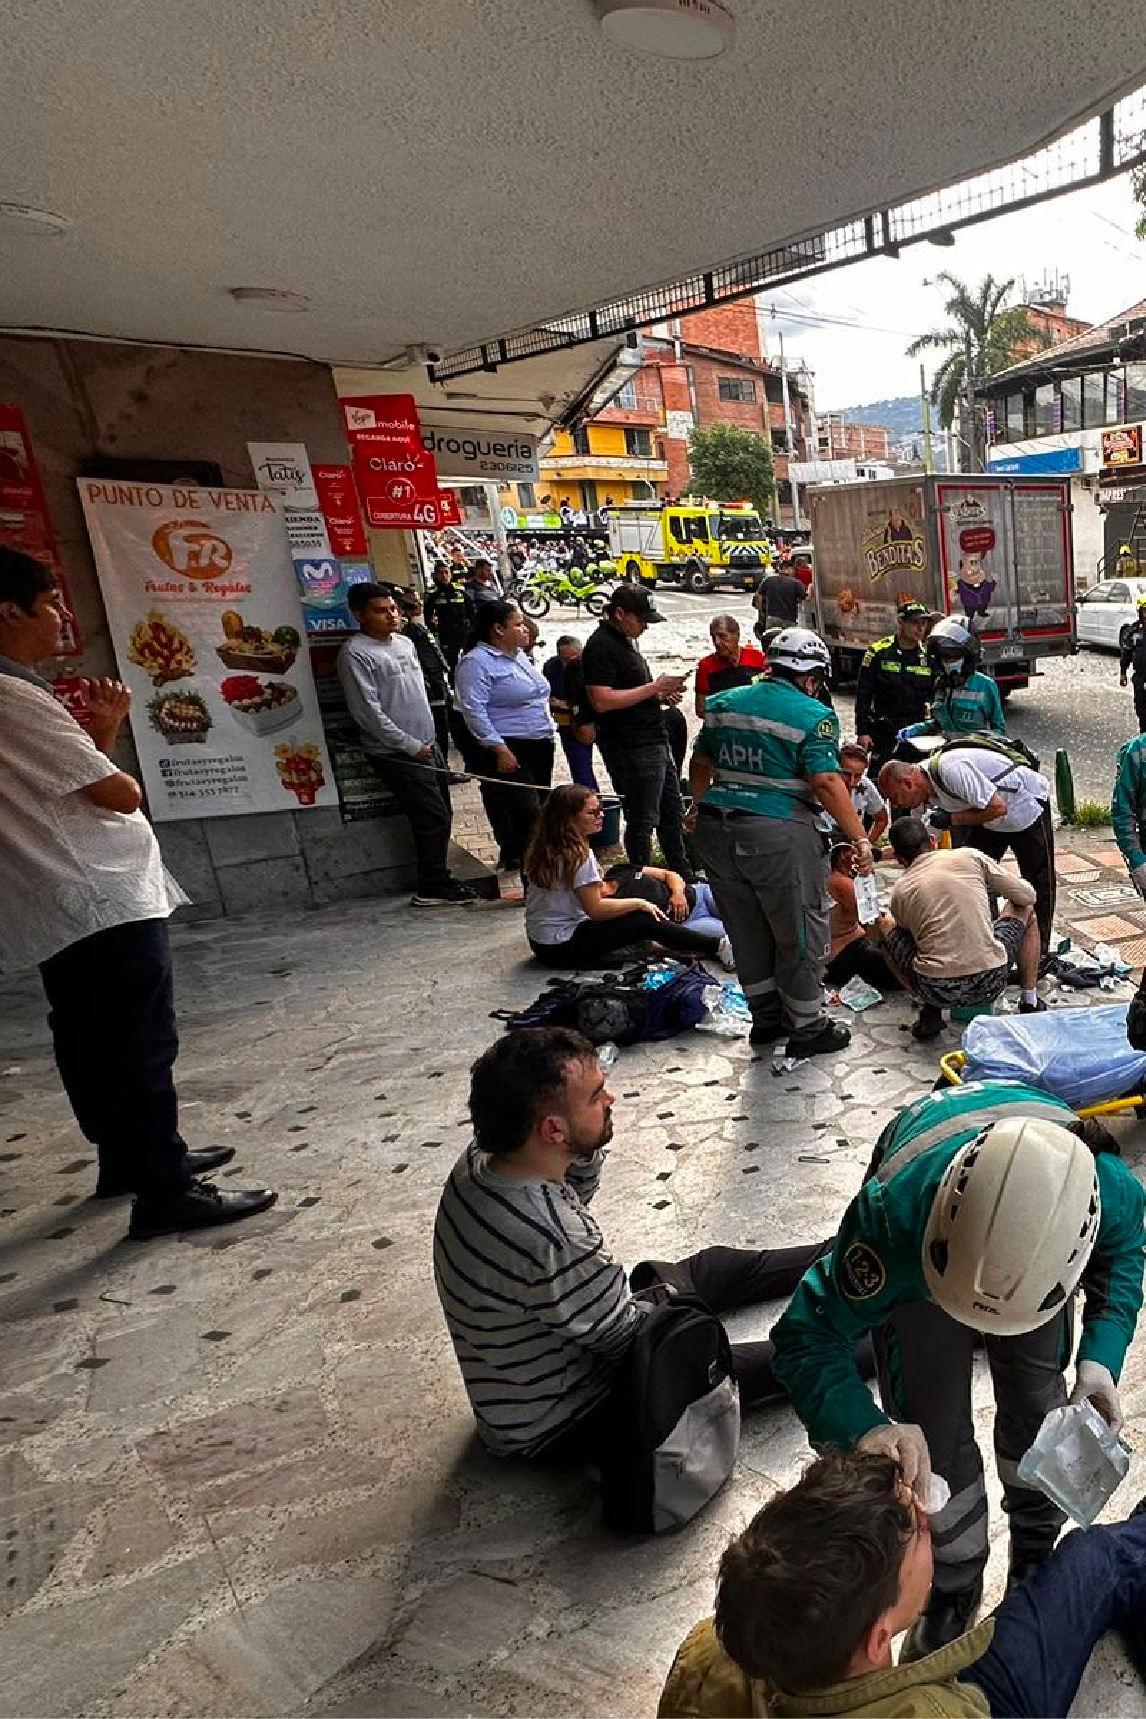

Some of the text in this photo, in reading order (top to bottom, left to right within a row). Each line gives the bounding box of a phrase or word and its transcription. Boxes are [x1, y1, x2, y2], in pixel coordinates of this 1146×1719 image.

[377, 418, 415, 431] mobile
[369, 456, 417, 472] Claro
[86, 483, 163, 507] PUNTO
[172, 489, 202, 509] DE
[208, 490, 276, 514] VENTA
[391, 485, 411, 498] #1
[413, 505, 435, 523] 4G
[311, 618, 346, 631] VISA
[718, 742, 763, 771] APH
